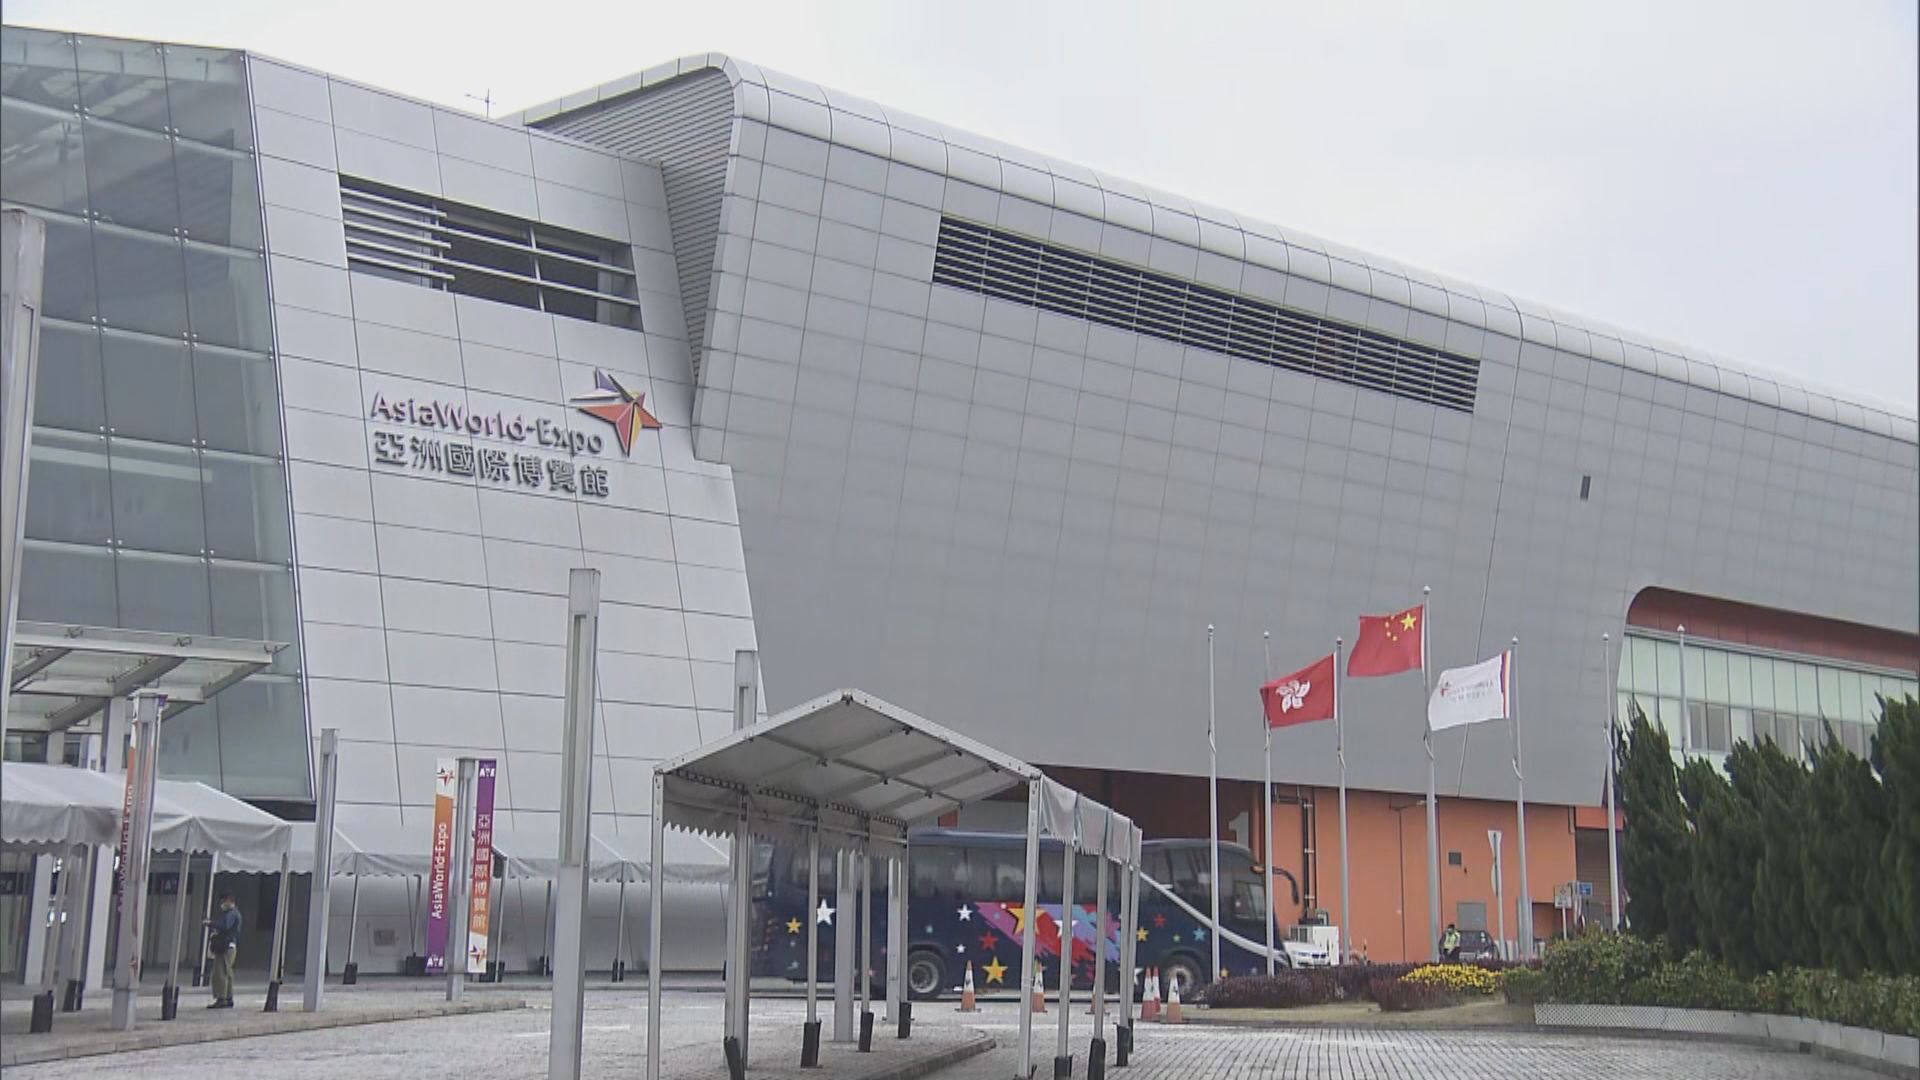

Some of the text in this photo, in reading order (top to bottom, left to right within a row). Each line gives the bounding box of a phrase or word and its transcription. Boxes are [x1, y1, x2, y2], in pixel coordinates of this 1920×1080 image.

[370, 391, 605, 456] AsiaWorld-Expo
[373, 431, 609, 497] 亞洲國際博覽館
[431, 822, 448, 919] AsiaWorld-Expo
